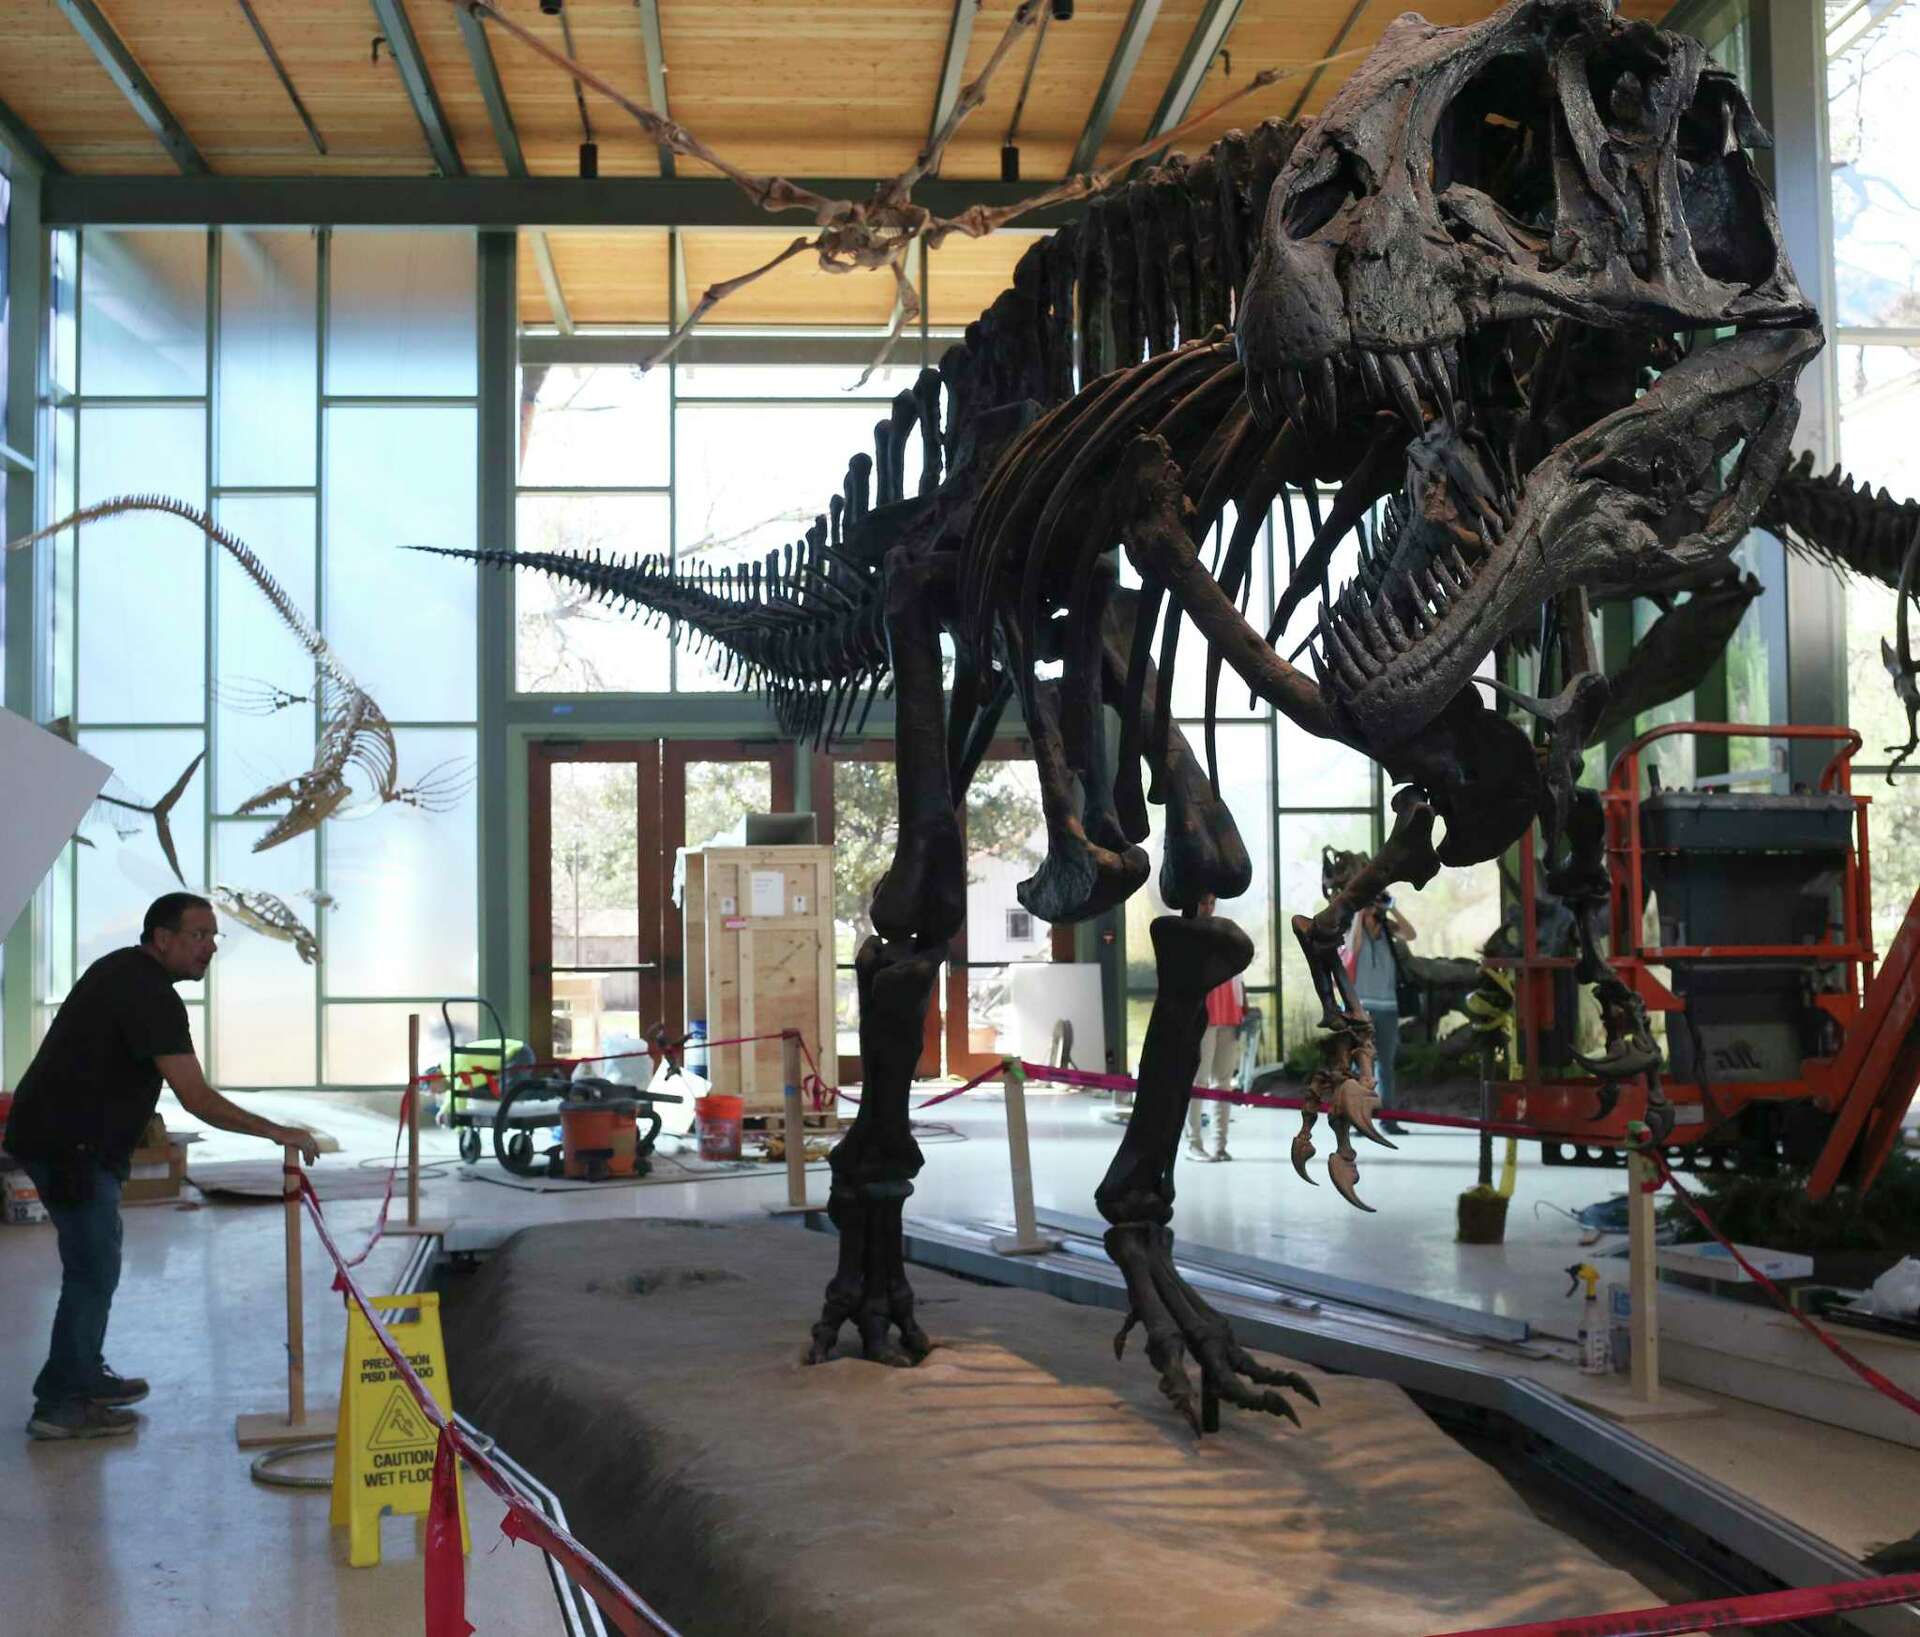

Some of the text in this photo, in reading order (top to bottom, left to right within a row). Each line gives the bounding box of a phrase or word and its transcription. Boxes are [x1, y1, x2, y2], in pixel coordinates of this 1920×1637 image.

[360, 1372, 386, 1383] PISO
[373, 1450, 434, 1468] CAUTION
[364, 1472, 394, 1487] WET
